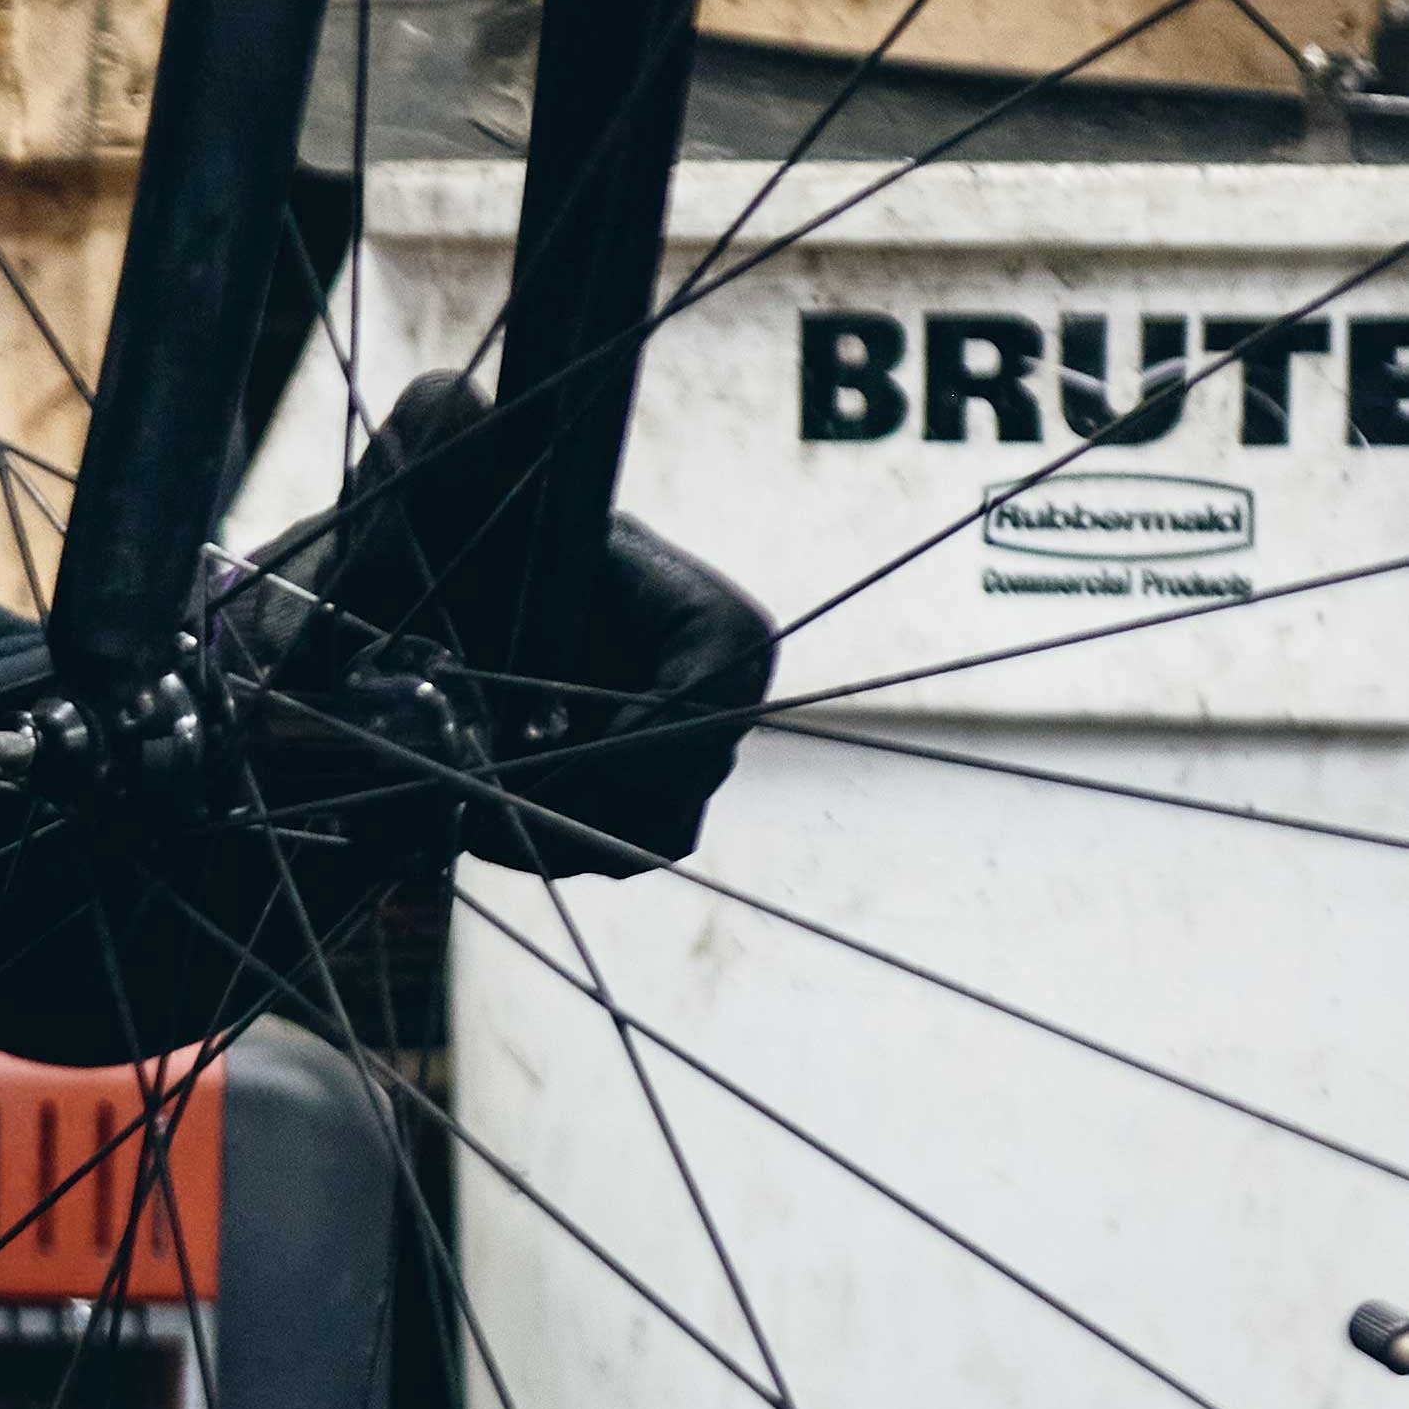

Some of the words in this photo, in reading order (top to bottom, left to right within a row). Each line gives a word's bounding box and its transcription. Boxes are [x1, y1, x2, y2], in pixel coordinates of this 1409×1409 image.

[994, 500, 1243, 533] Rubbermaid
[981, 566, 1132, 596] Commercial
[1141, 567, 1253, 596] Products
